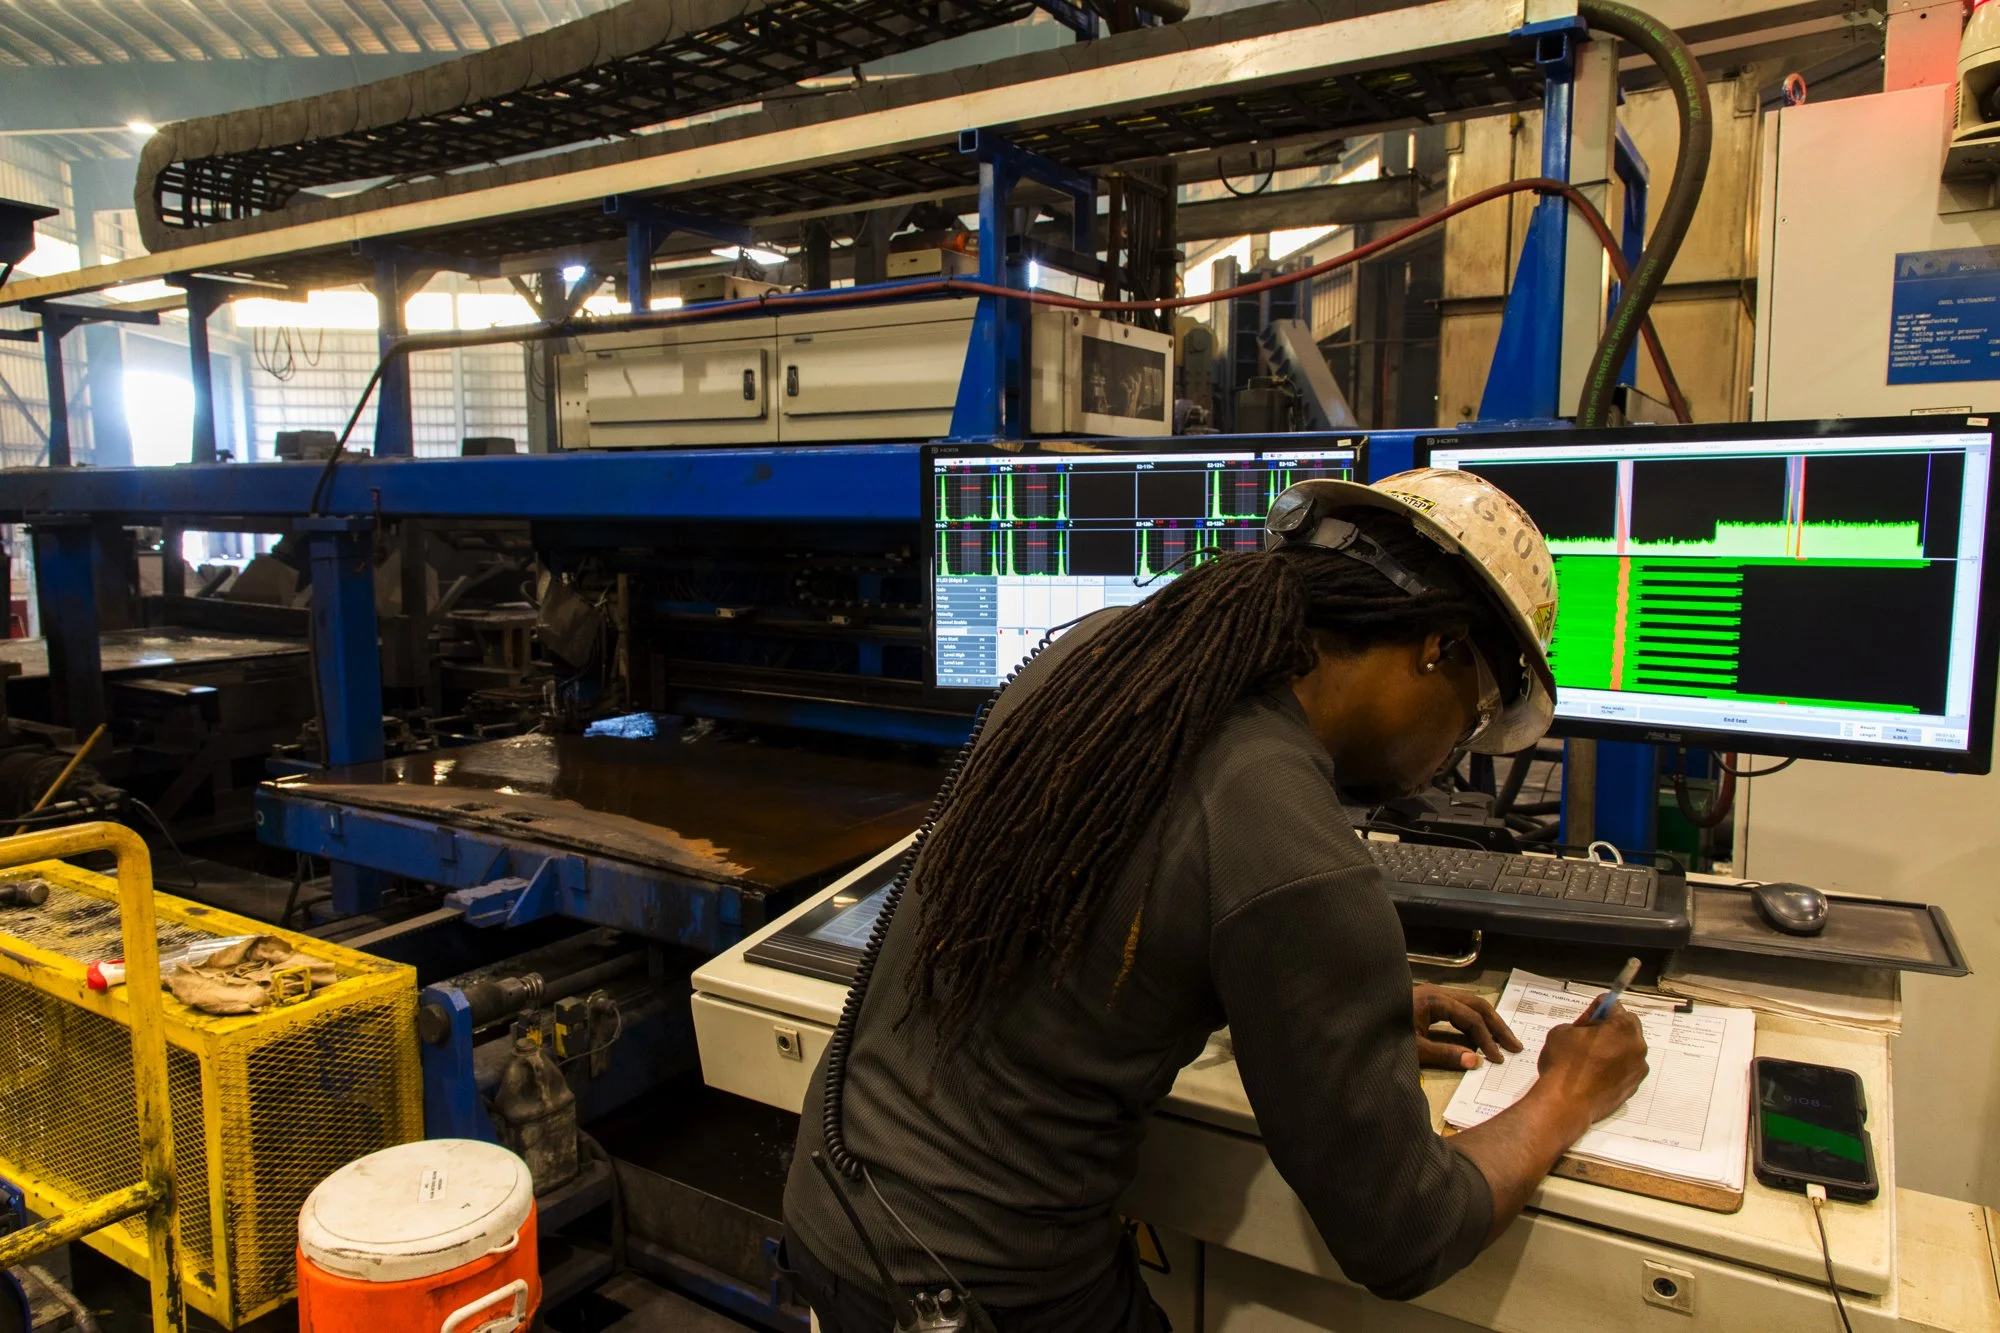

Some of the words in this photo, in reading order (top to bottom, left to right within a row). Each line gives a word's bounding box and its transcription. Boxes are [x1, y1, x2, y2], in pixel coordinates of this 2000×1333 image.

[1593, 342, 1618, 389] GENERAL
[1611, 294, 1640, 340] PURPOSE
[1403, 496, 1427, 511] STEP
[1645, 732, 1682, 743] ASUS
[1528, 989, 1550, 998] JINDAL
[1552, 994, 1581, 1004] TUBULAR
[1783, 1094, 1821, 1108] 9:08
